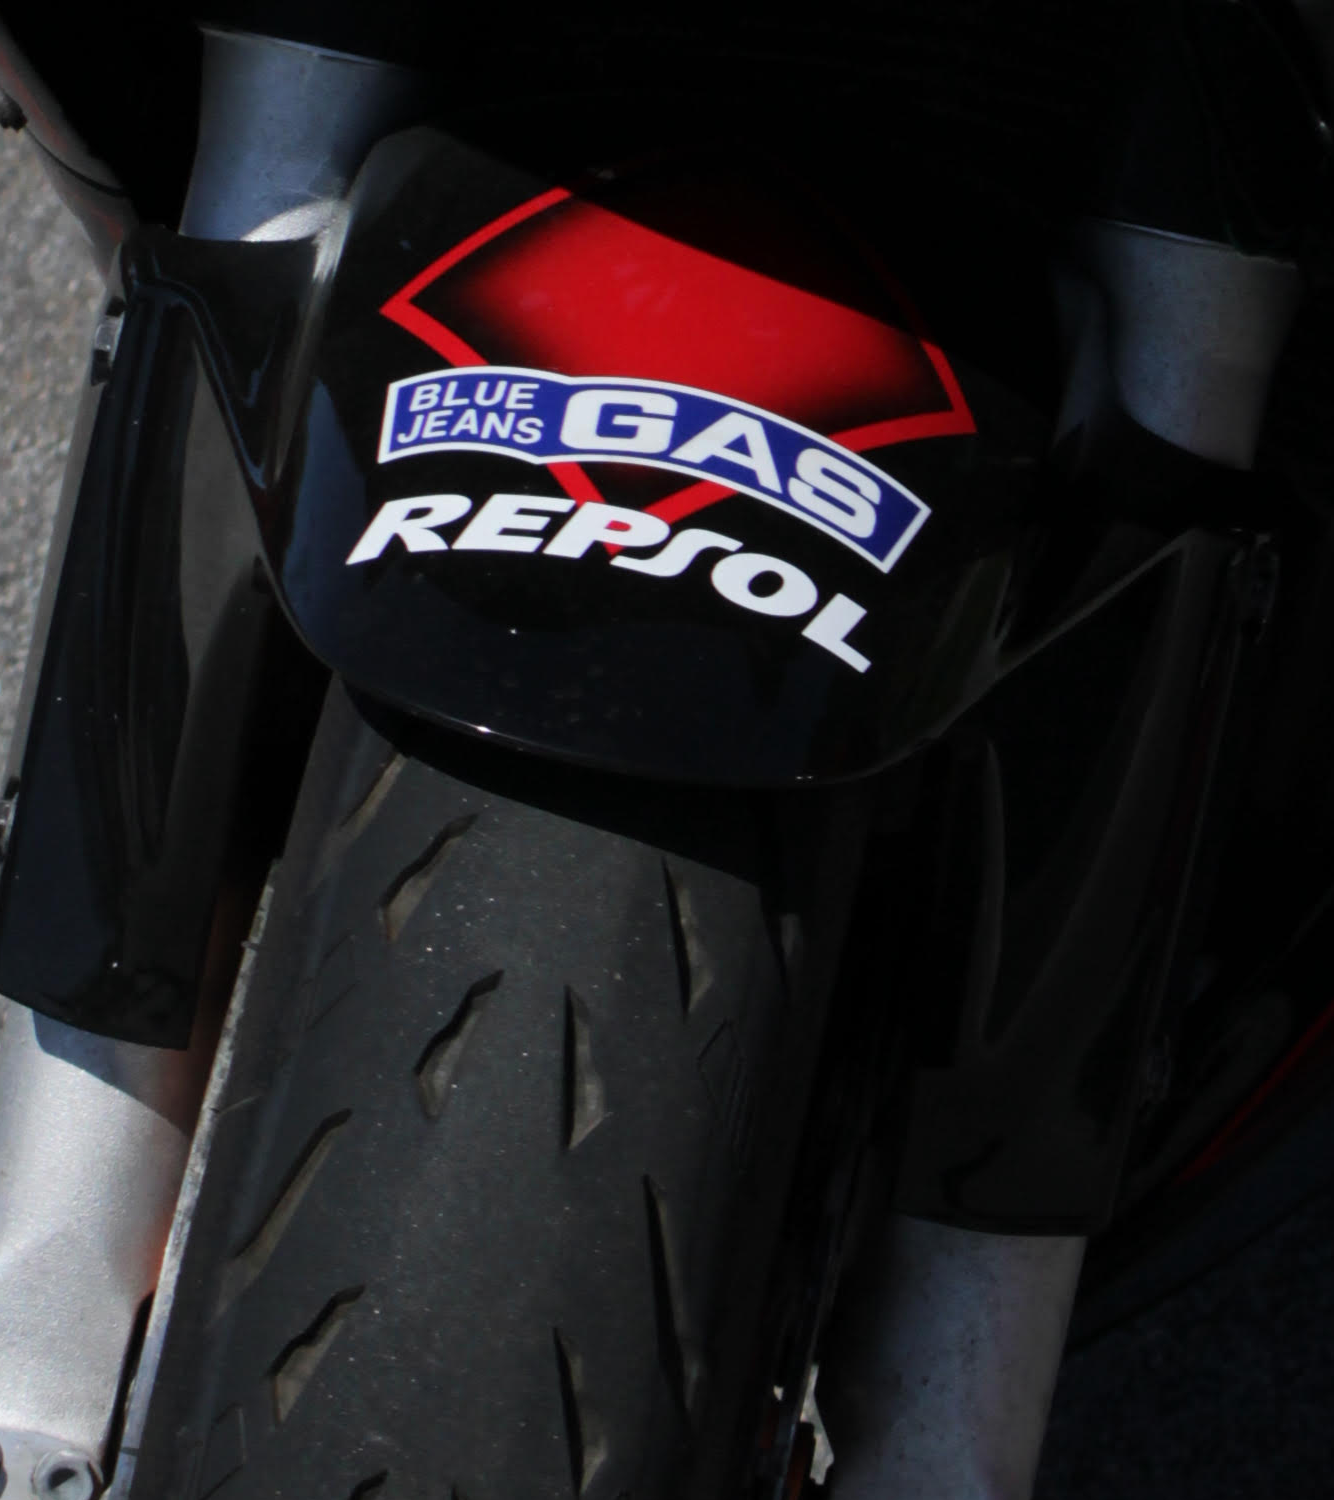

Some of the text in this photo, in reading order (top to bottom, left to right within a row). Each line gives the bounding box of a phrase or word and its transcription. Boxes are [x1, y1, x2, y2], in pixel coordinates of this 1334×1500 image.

[396, 408, 544, 445] JEANS
[408, 382, 540, 413] BLUE
[559, 388, 882, 540] GAS
[345, 493, 872, 674] REPSOL
